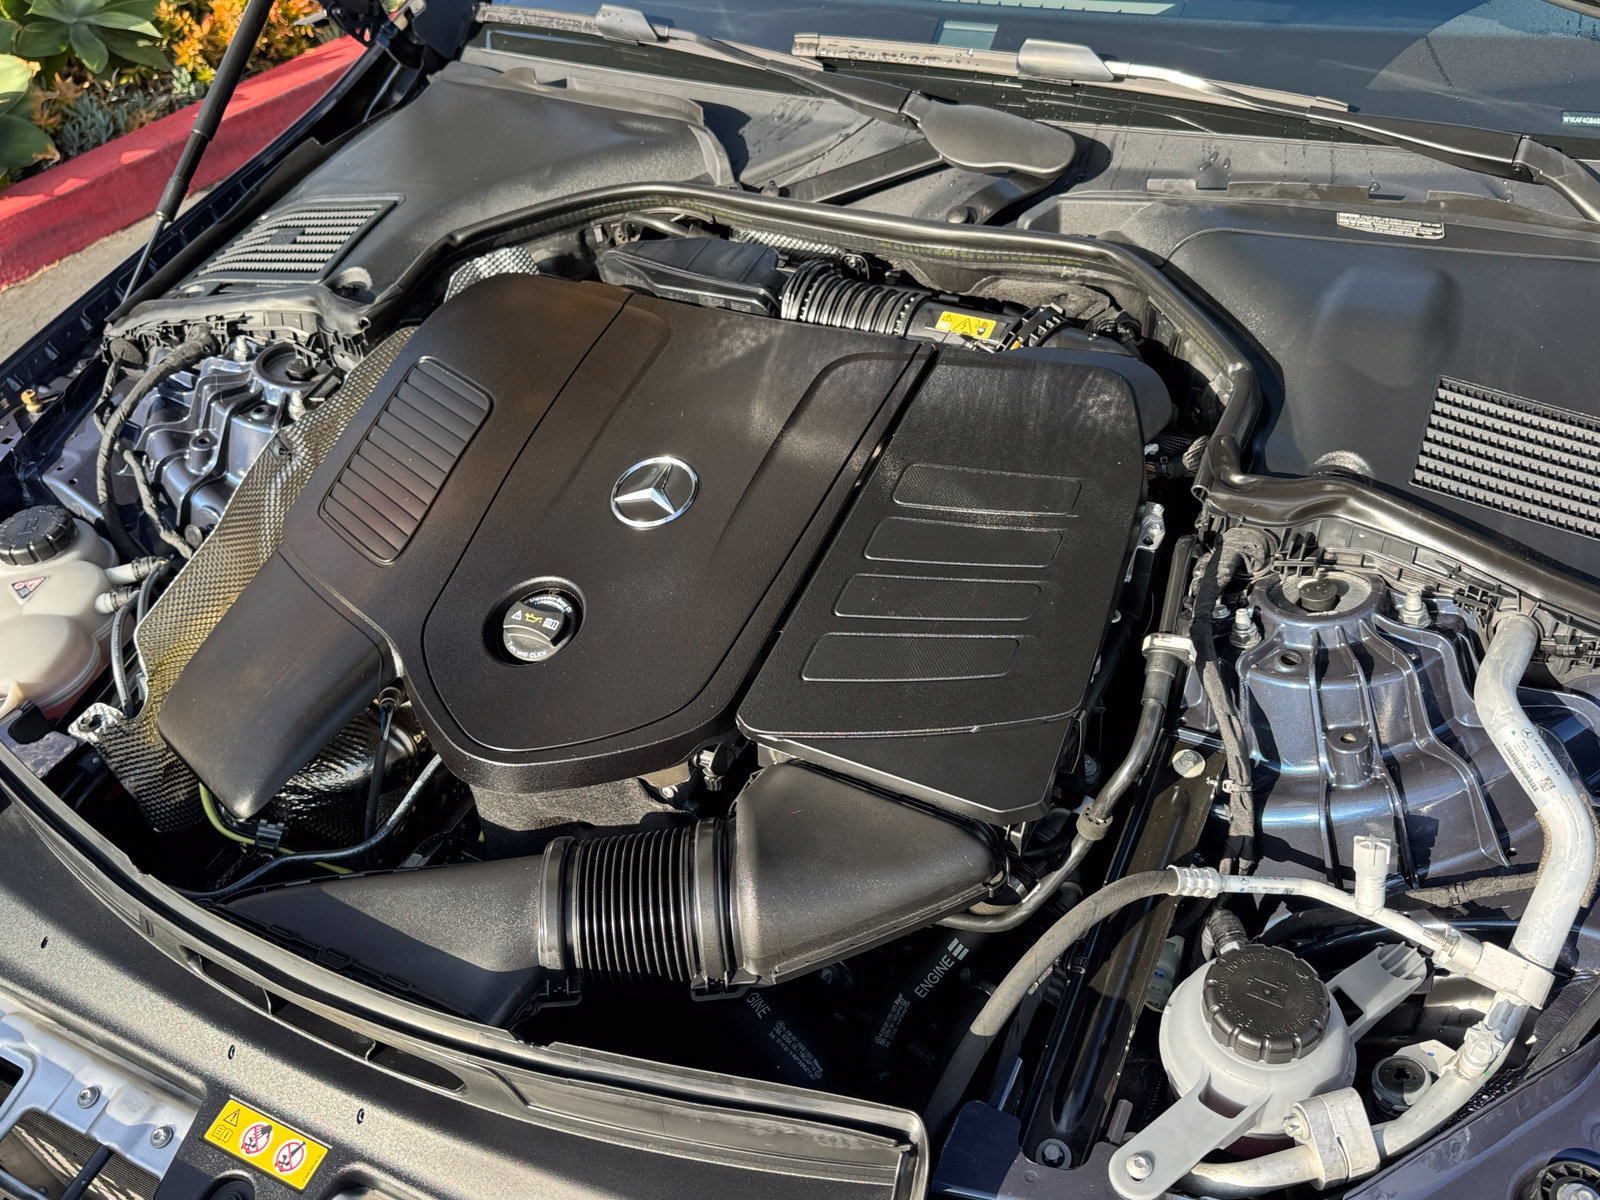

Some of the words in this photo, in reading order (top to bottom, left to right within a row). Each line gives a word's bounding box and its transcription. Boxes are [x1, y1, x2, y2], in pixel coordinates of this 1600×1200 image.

[507, 640, 517, 653] Turn
[516, 650, 528, 658] until
[529, 650, 547, 658] CLICK
[914, 954, 955, 998] ENGINE
[746, 992, 771, 1019] GINE
